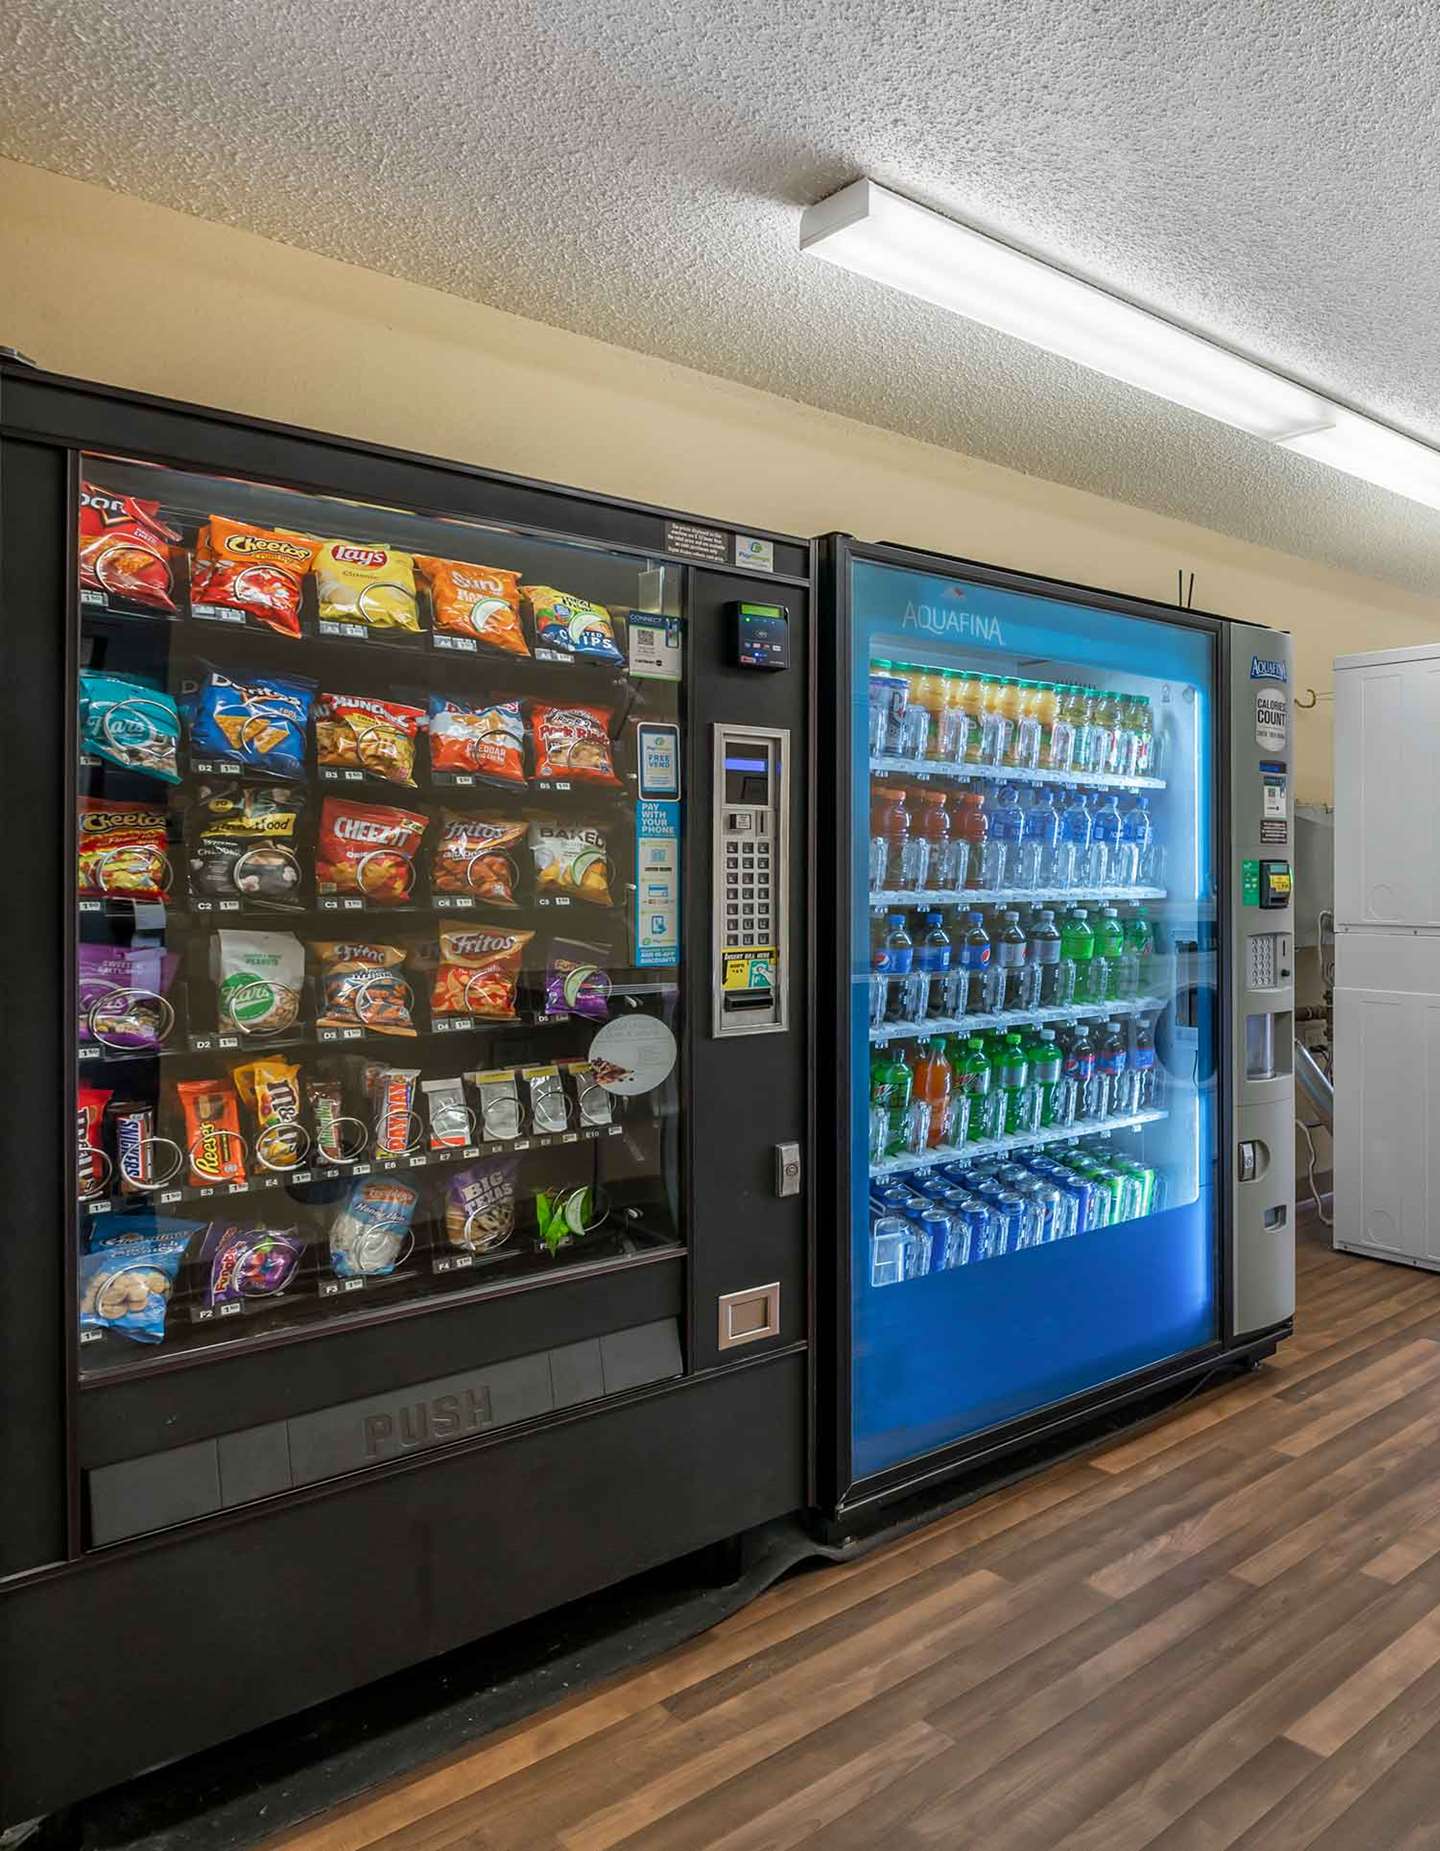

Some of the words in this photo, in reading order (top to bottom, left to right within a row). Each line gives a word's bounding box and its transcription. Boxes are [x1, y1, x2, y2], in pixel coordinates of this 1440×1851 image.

[226, 535, 311, 561] Cheetos
[902, 600, 1007, 646] AQUAFINA
[559, 627, 613, 650] CIPS
[1257, 710, 1286, 726] COUNT
[641, 818, 668, 826] YOUR
[641, 826, 675, 834] PHONE
[388, 1080, 409, 1152] PAYDAY
[120, 1119, 140, 1177] SNICKERS
[462, 1171, 504, 1202] BIG
[360, 1385, 493, 1460] PUSH
